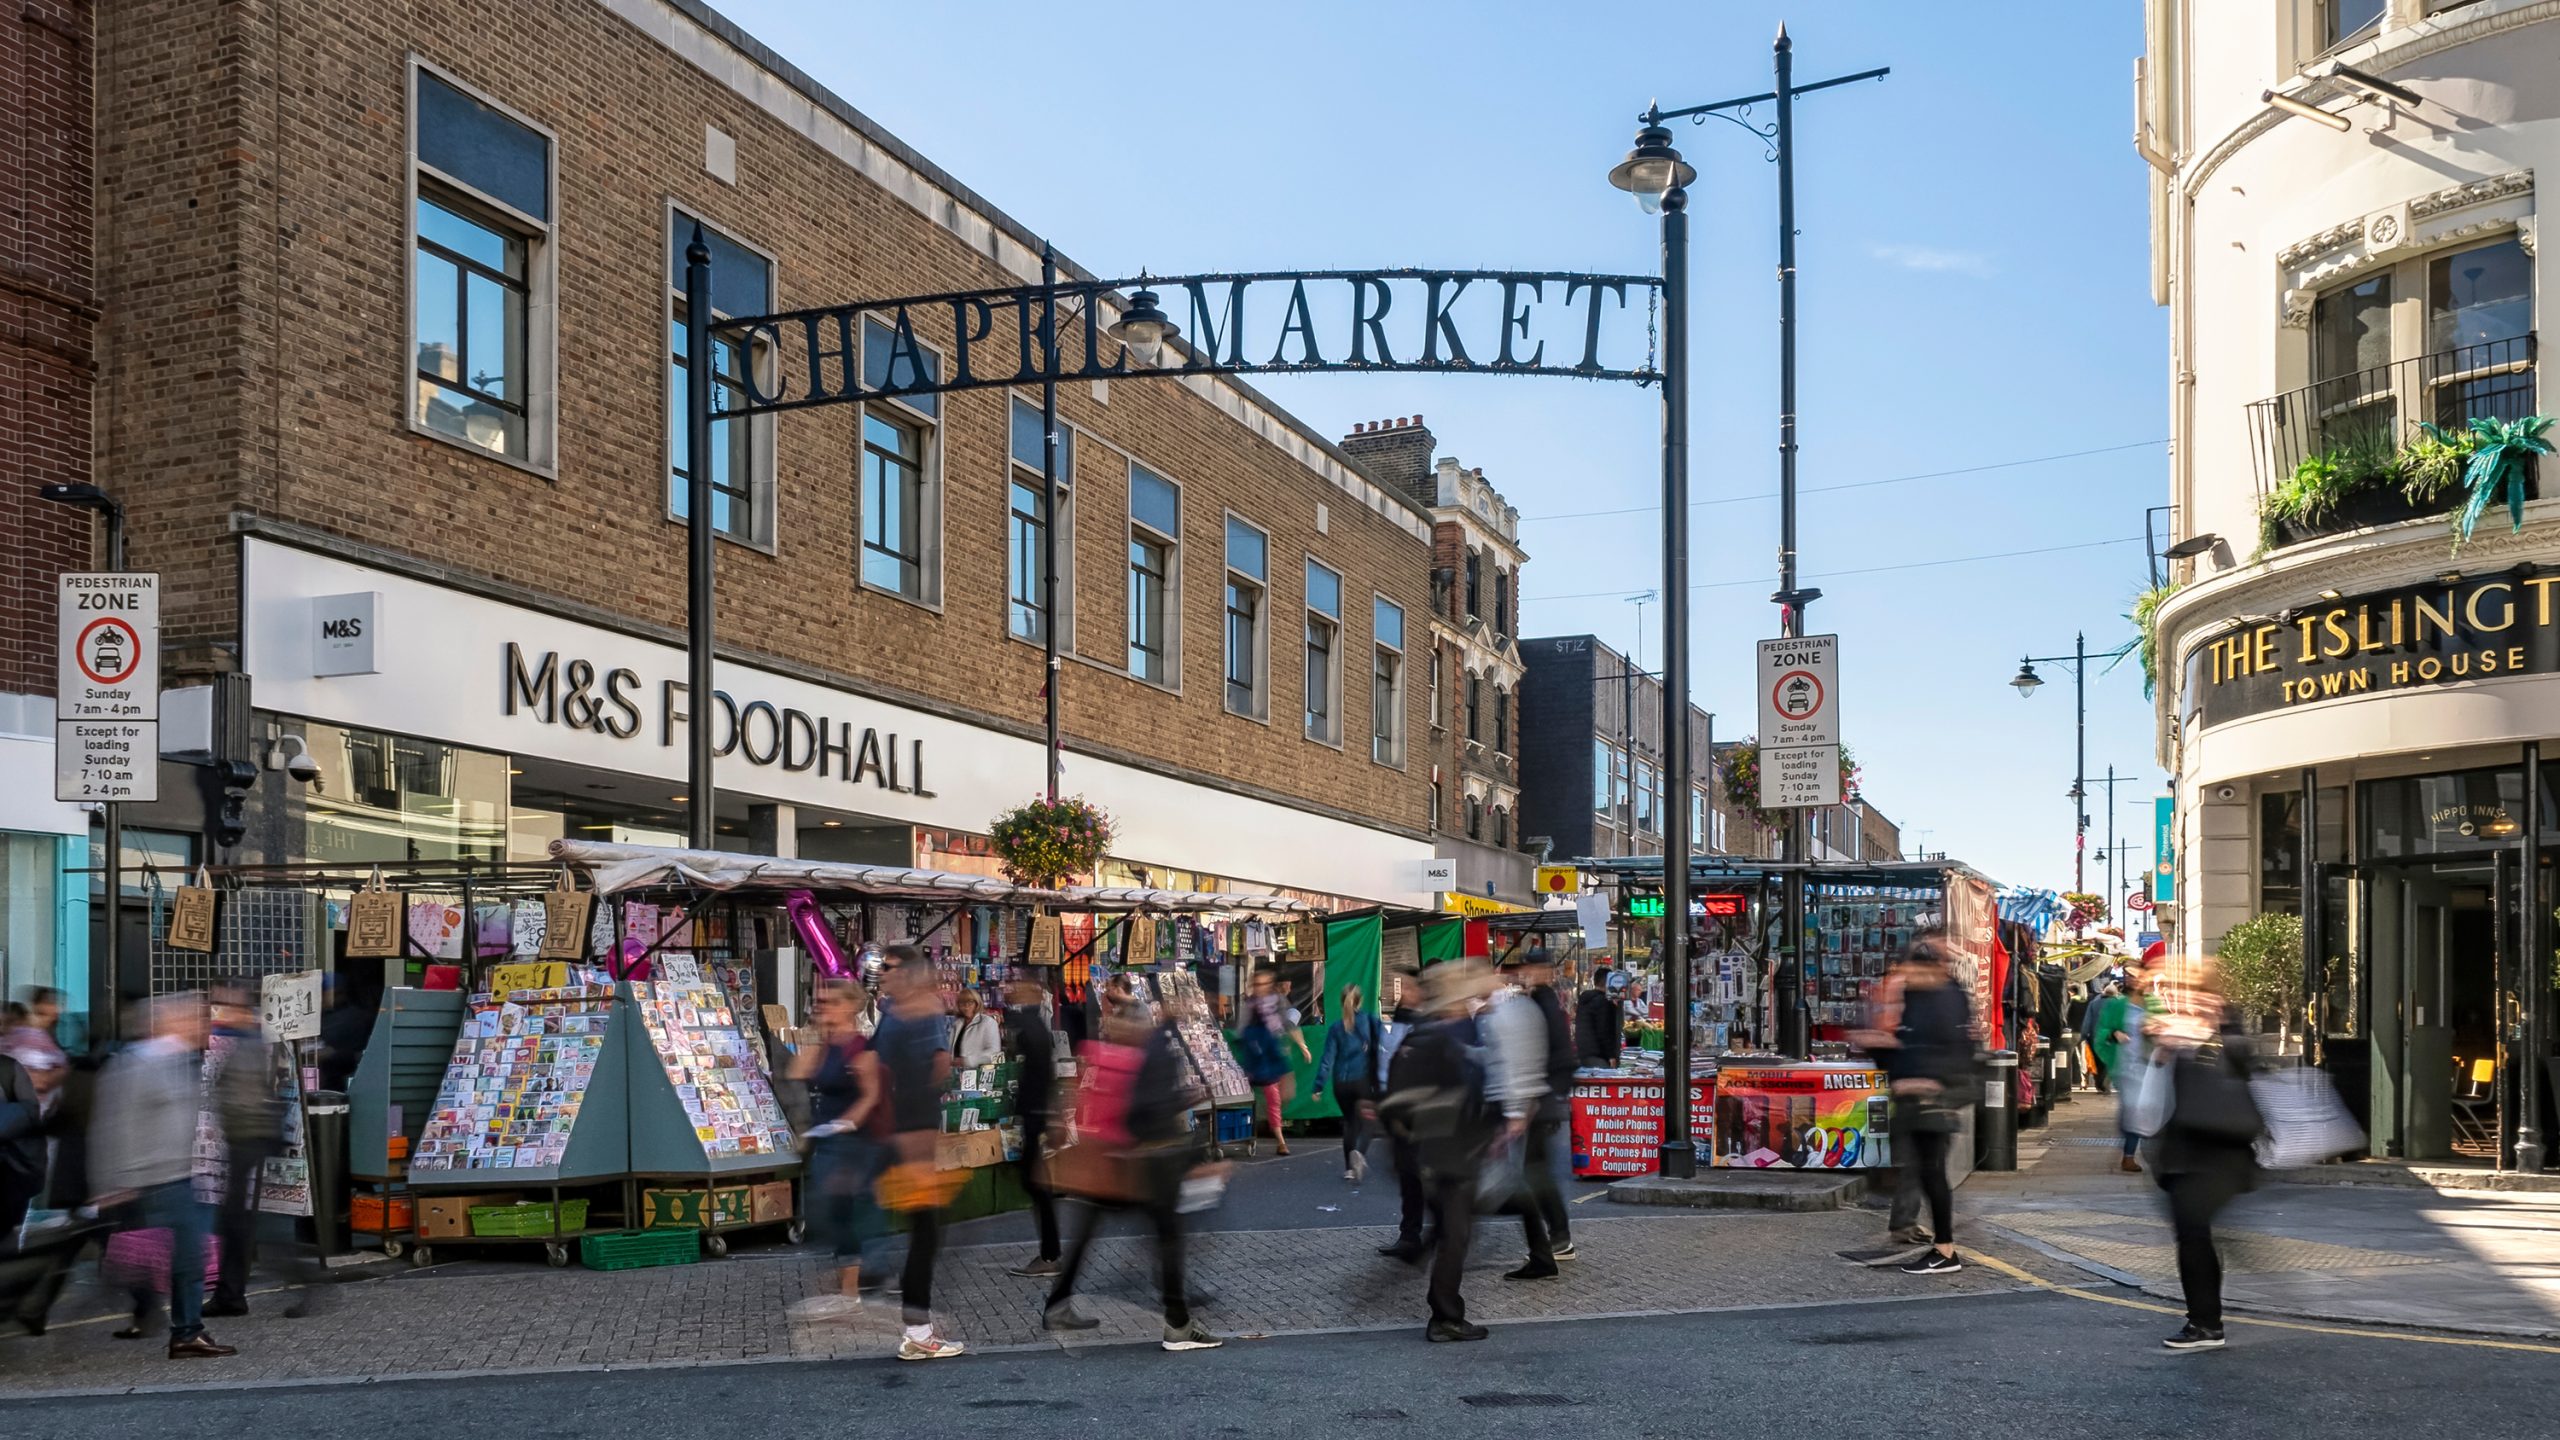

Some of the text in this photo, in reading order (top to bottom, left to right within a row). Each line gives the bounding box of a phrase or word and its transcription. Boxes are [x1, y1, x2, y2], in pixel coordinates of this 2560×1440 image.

[740, 277, 1627, 406] CHAPEL MARKET
[66, 577, 152, 588] PEDESTRIAN
[78, 593, 139, 610] ZONE
[323, 618, 361, 639] M&S
[2208, 577, 2560, 684] THE ISLINGT
[1764, 639, 1831, 652] PEDESTRIAN
[1773, 652, 1821, 667] ZONE
[2282, 646, 2525, 703] TOWN HOUSE
[85, 689, 131, 701] Sunday
[111, 704, 120, 714] 4
[122, 706, 141, 718] pm
[506, 641, 937, 798] M&S FOODHALL
[76, 726, 139, 738] Except for
[1781, 723, 1817, 733] Sunday
[85, 739, 130, 752] loading
[85, 755, 130, 767] Sunday
[1774, 750, 1825, 761] Except for
[1782, 761, 1817, 771] loading
[81, 770, 89, 780] 7
[98, 770, 112, 780] 10
[113, 772, 133, 780] am
[1782, 772, 1818, 782] Sunday
[83, 785, 91, 795] 2
[101, 785, 110, 795] 4
[112, 787, 131, 798] pm
[1792, 783, 1804, 791] 10
[1794, 794, 1801, 802] 4
[1804, 795, 1819, 804] pm
[2431, 805, 2503, 824] HIPPO INNS
[2160, 823, 2169, 857] Potential
[1428, 868, 1448, 878] M&S
[1747, 1071, 1792, 1079] MOBILE
[1725, 1080, 1815, 1088] ACCESSORIES
[1823, 1073, 1870, 1090] ANGEL
[1569, 1086, 1702, 1099] GEL PHOS
[1586, 1105, 1600, 1115] We
[1601, 1105, 1629, 1116] Repair
[1632, 1105, 1647, 1116] And
[1596, 1119, 1657, 1130] Mobile Phones
[1592, 1133, 1658, 1144] All Accessories
[1592, 1146, 1658, 1158] For Phones And
